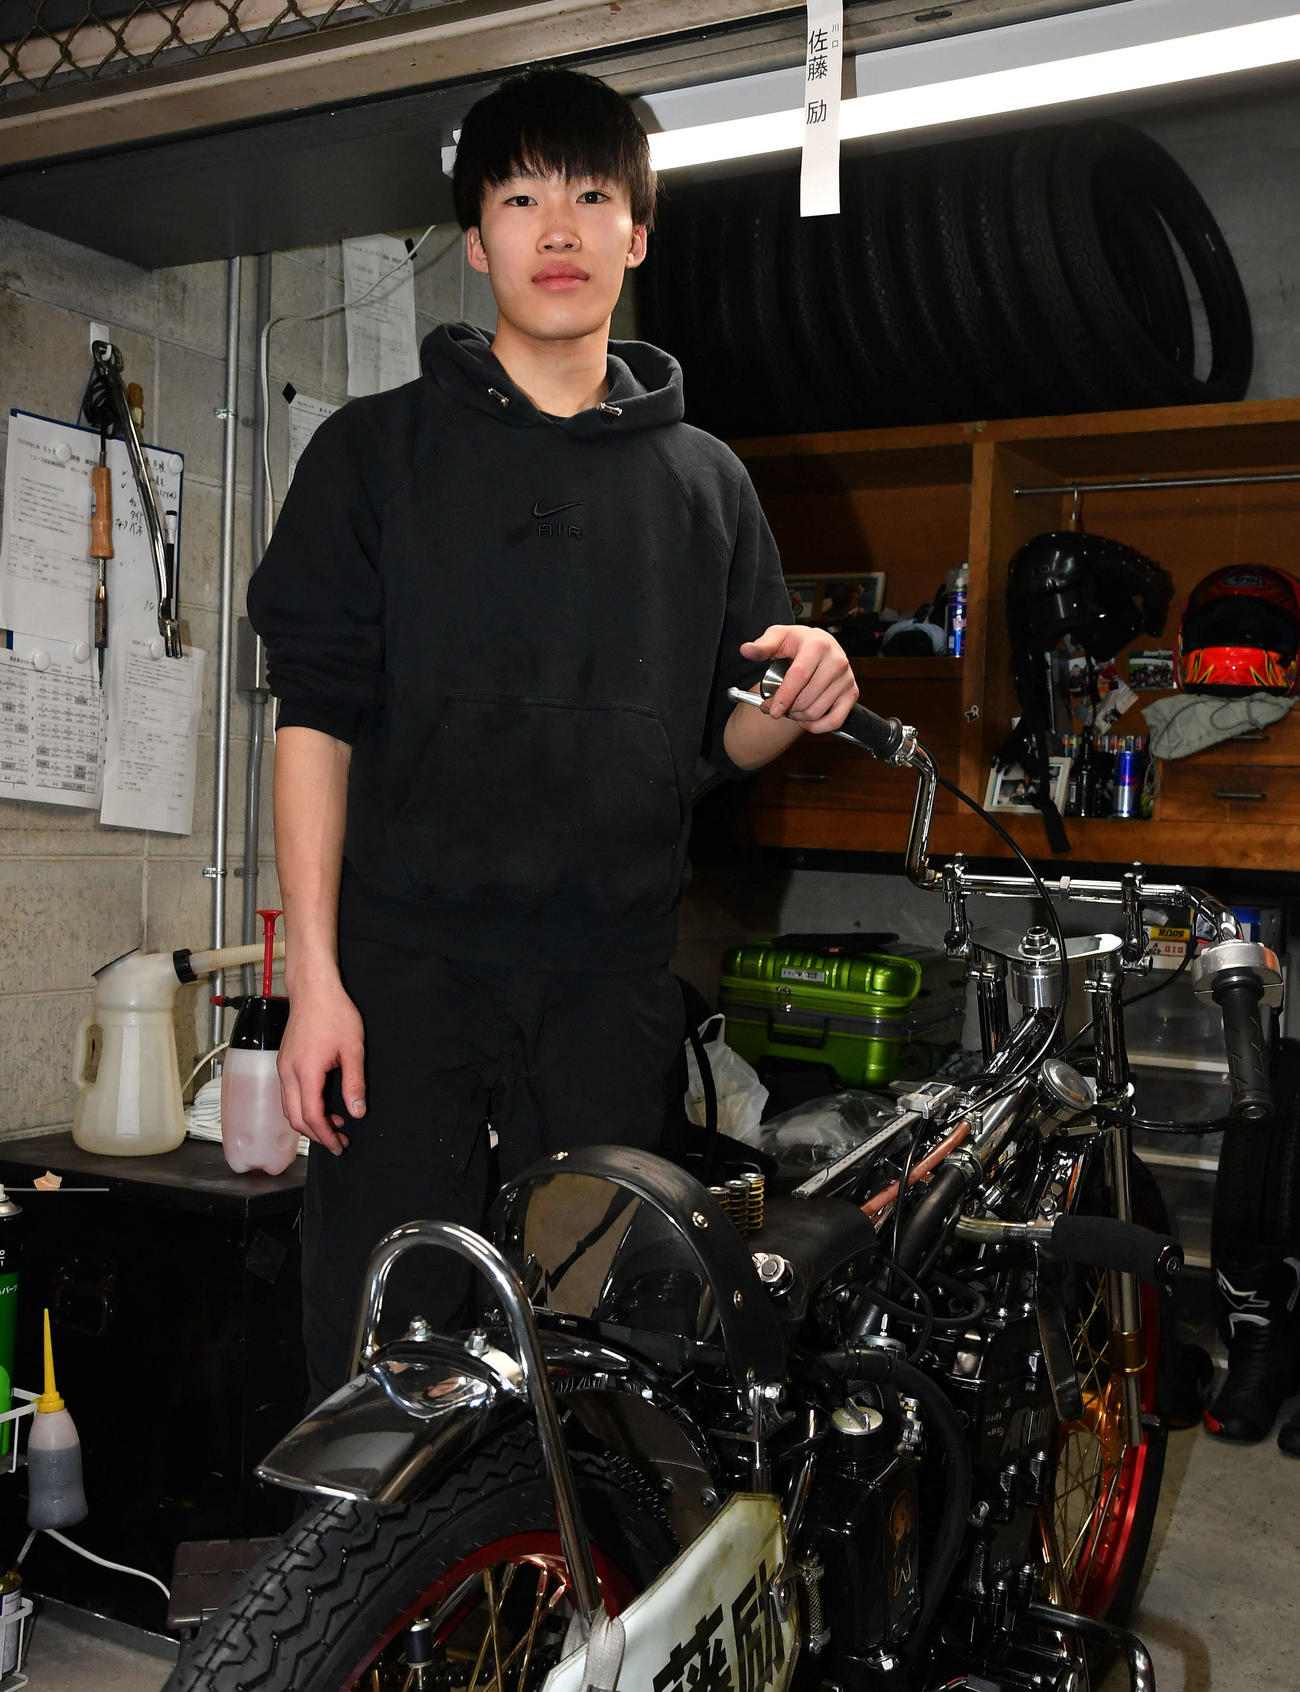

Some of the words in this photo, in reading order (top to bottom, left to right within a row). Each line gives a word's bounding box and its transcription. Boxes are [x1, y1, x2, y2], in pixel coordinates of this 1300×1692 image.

[832, 22, 840, 48] 川口
[808, 28, 829, 82] 佐藤
[806, 98, 828, 125] 励
[538, 521, 582, 538] AIR
